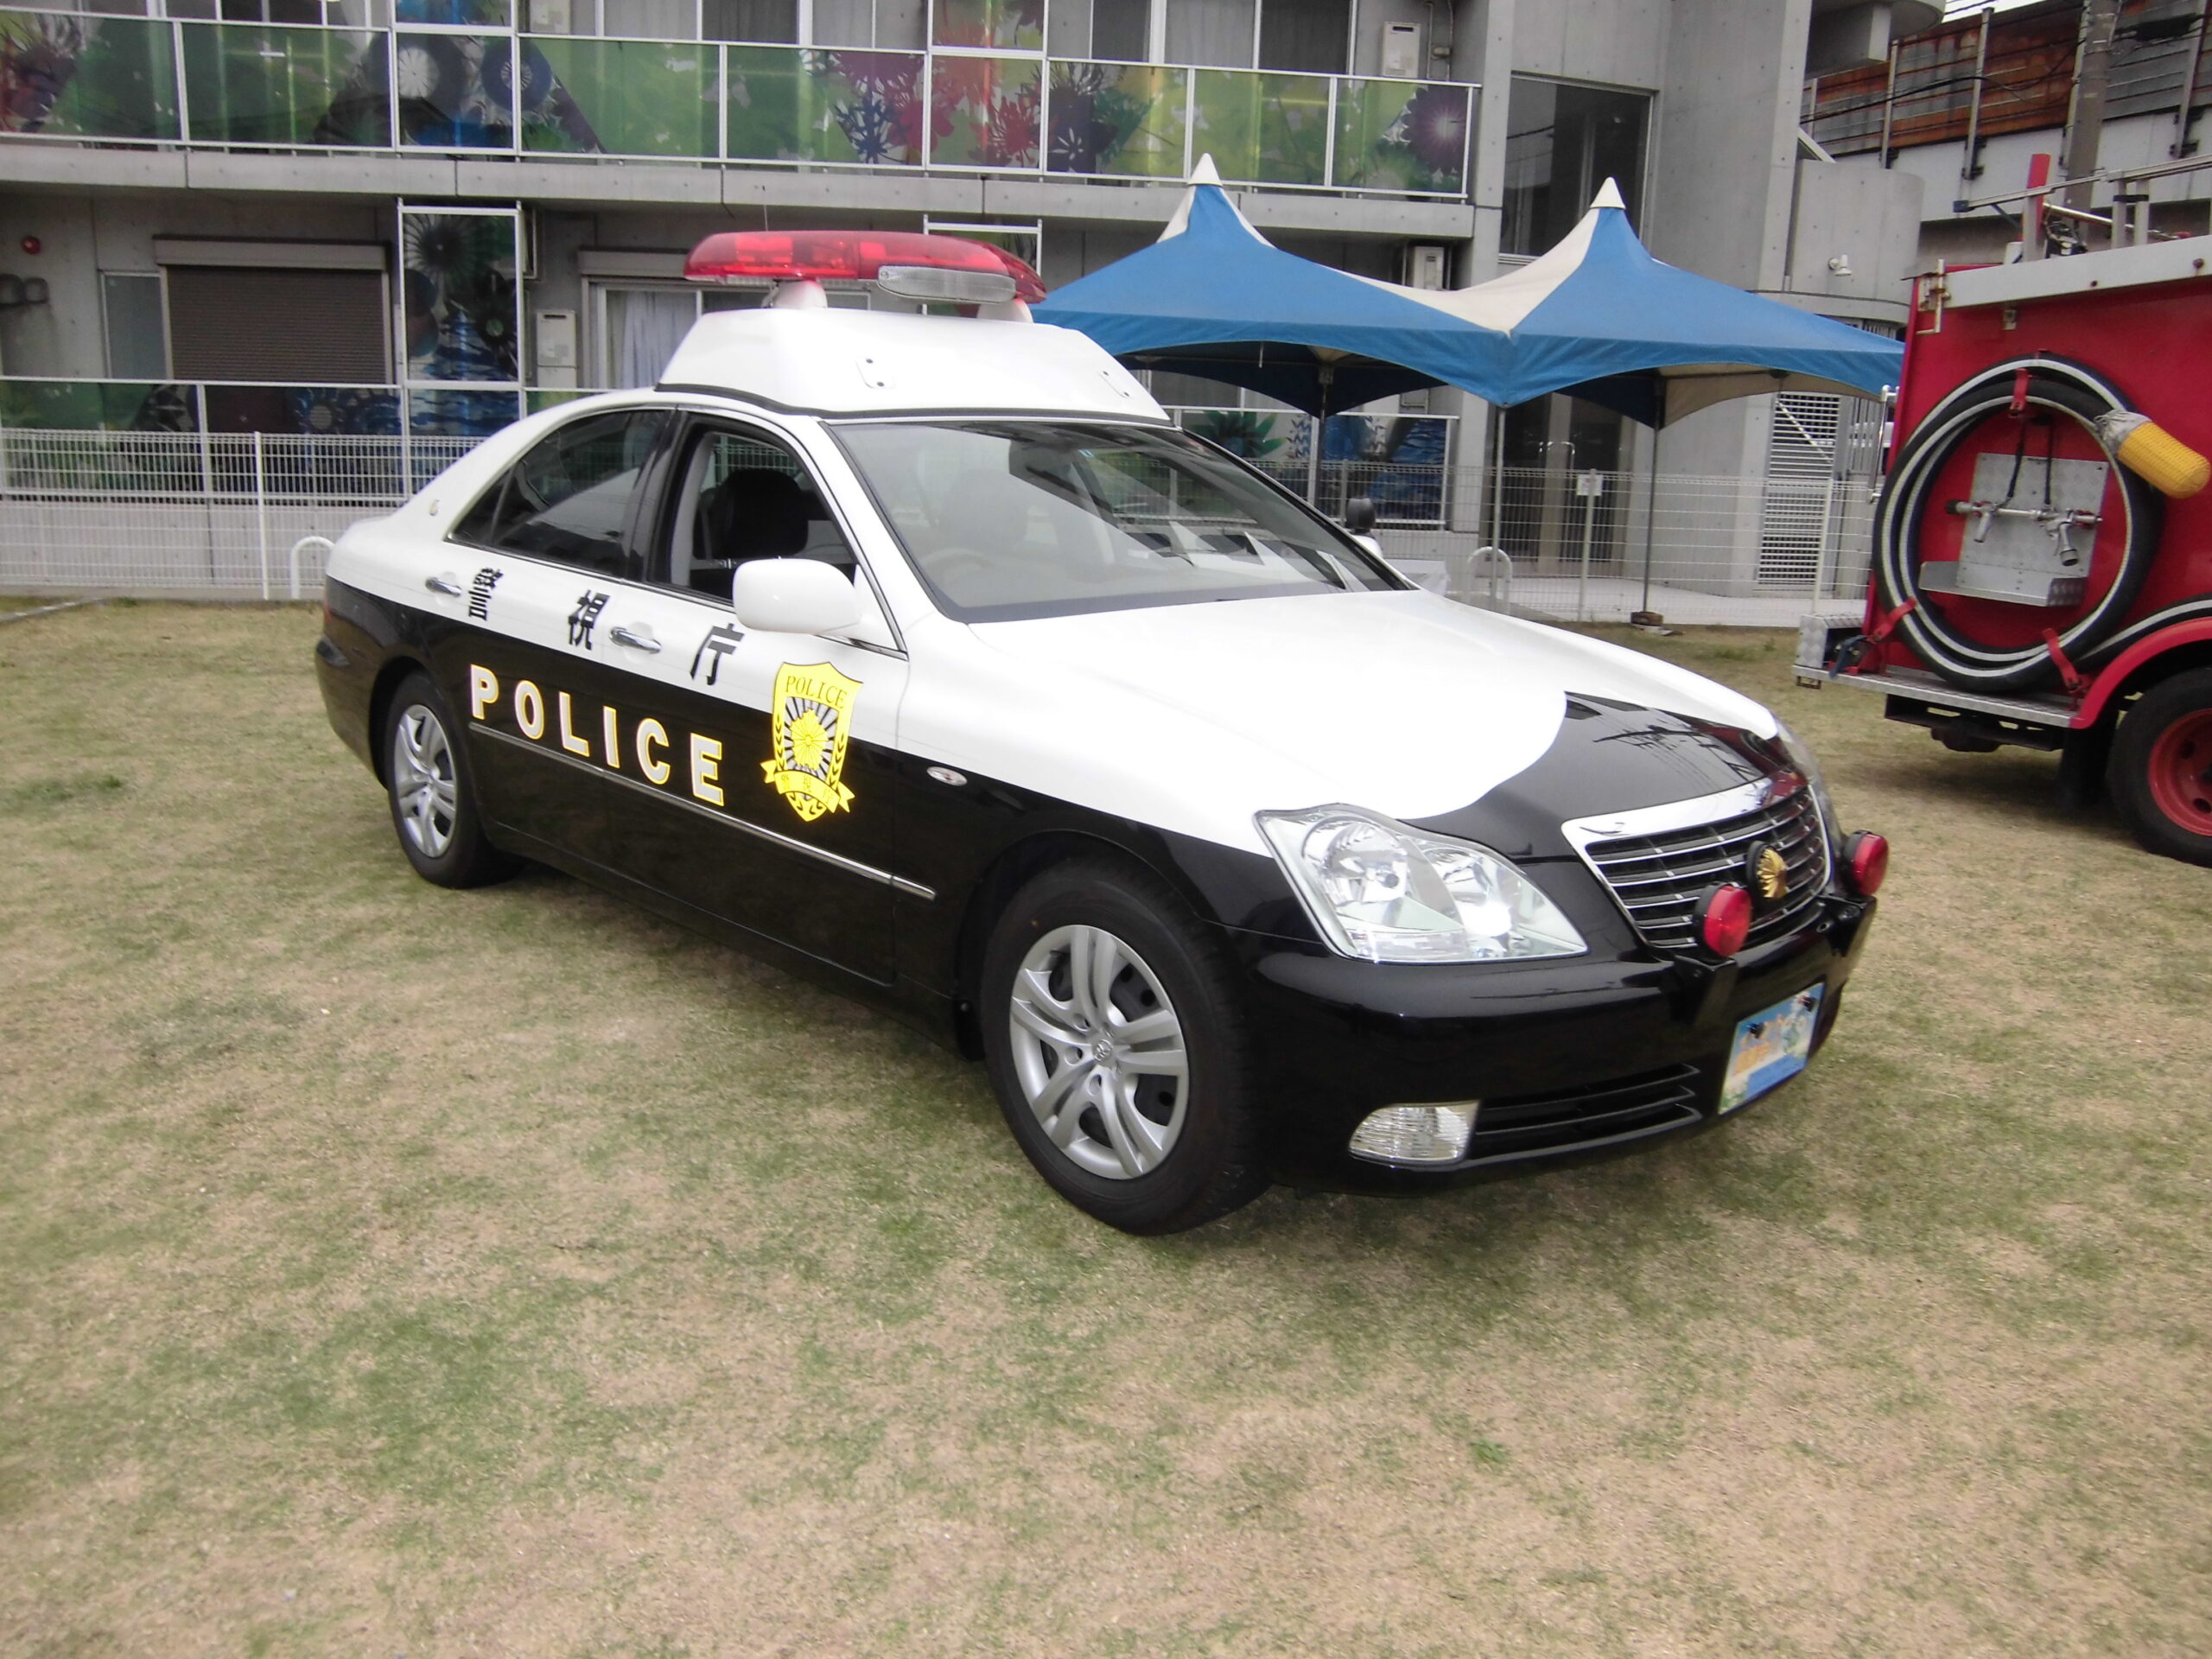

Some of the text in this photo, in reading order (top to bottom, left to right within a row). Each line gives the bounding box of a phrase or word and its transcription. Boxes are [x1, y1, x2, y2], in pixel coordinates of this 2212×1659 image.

[468, 567, 745, 686] 警視庁
[470, 664, 725, 806] POLICE
[785, 675, 848, 709] POLICE
